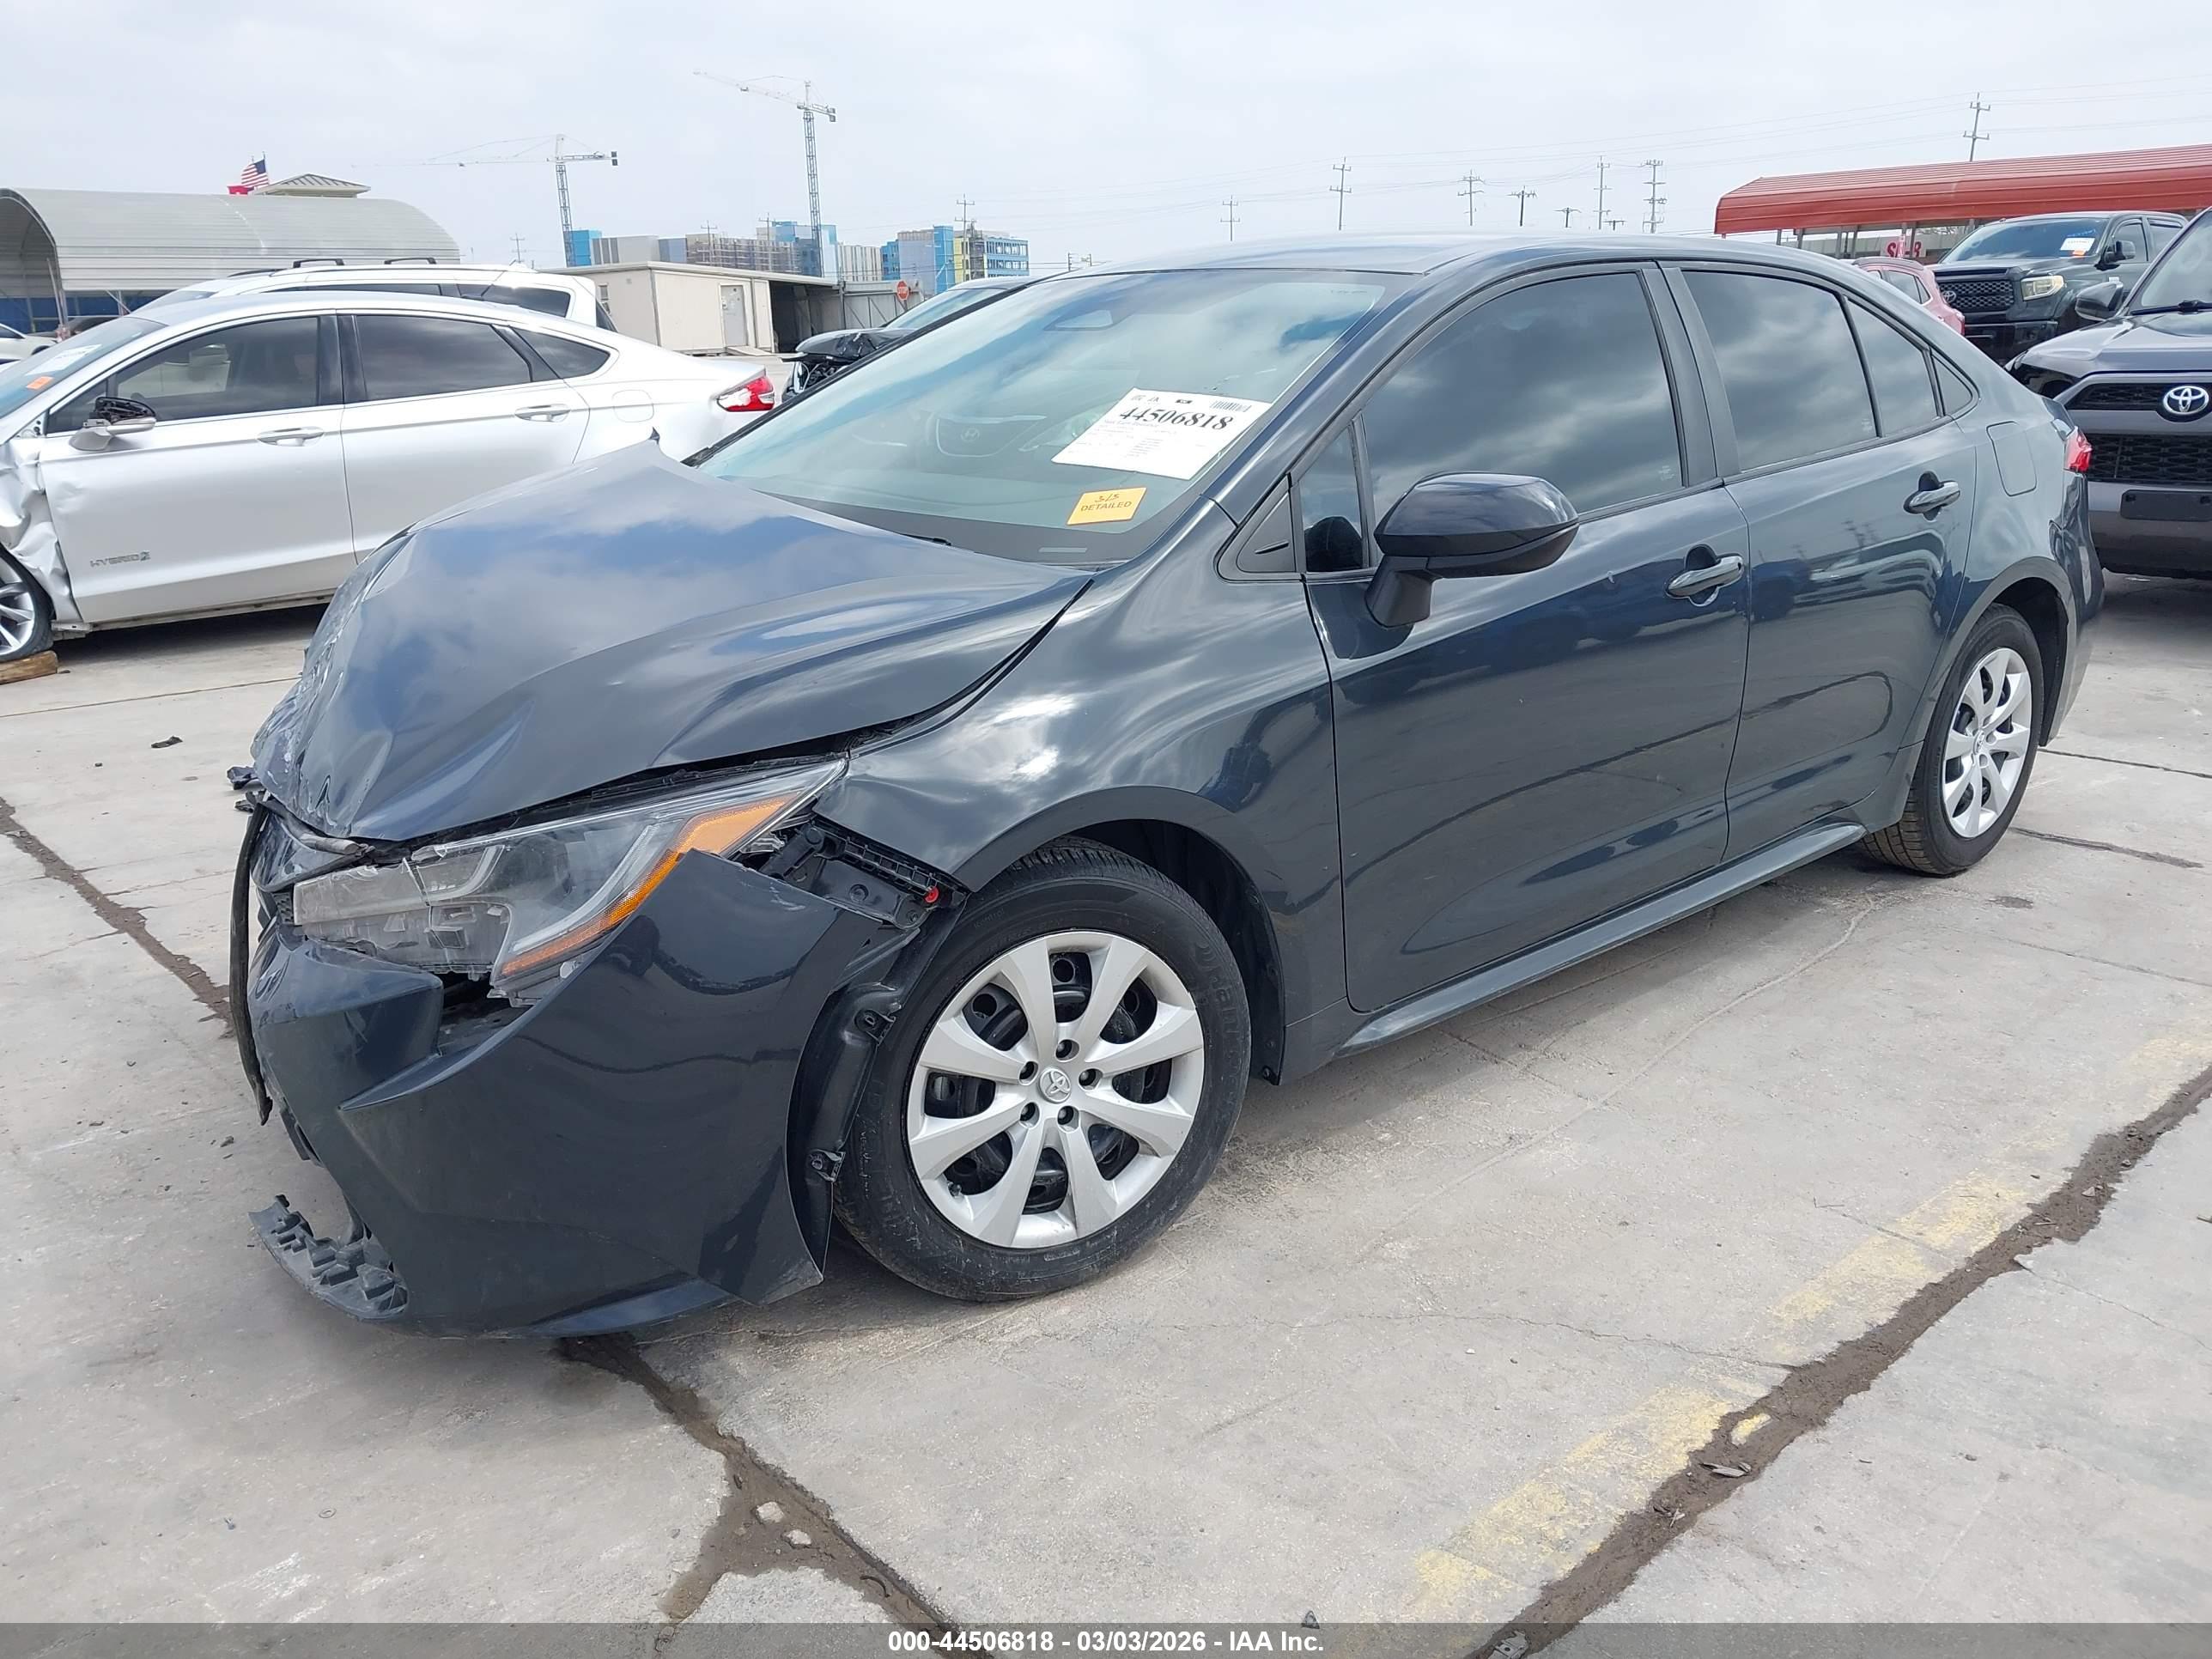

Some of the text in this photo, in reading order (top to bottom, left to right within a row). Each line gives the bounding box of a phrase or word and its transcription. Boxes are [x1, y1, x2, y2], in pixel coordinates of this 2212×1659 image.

[1120, 407, 1234, 429] 44506818
[1080, 501, 1133, 512] DETAILED
[89, 554, 139, 568] HYBRID
